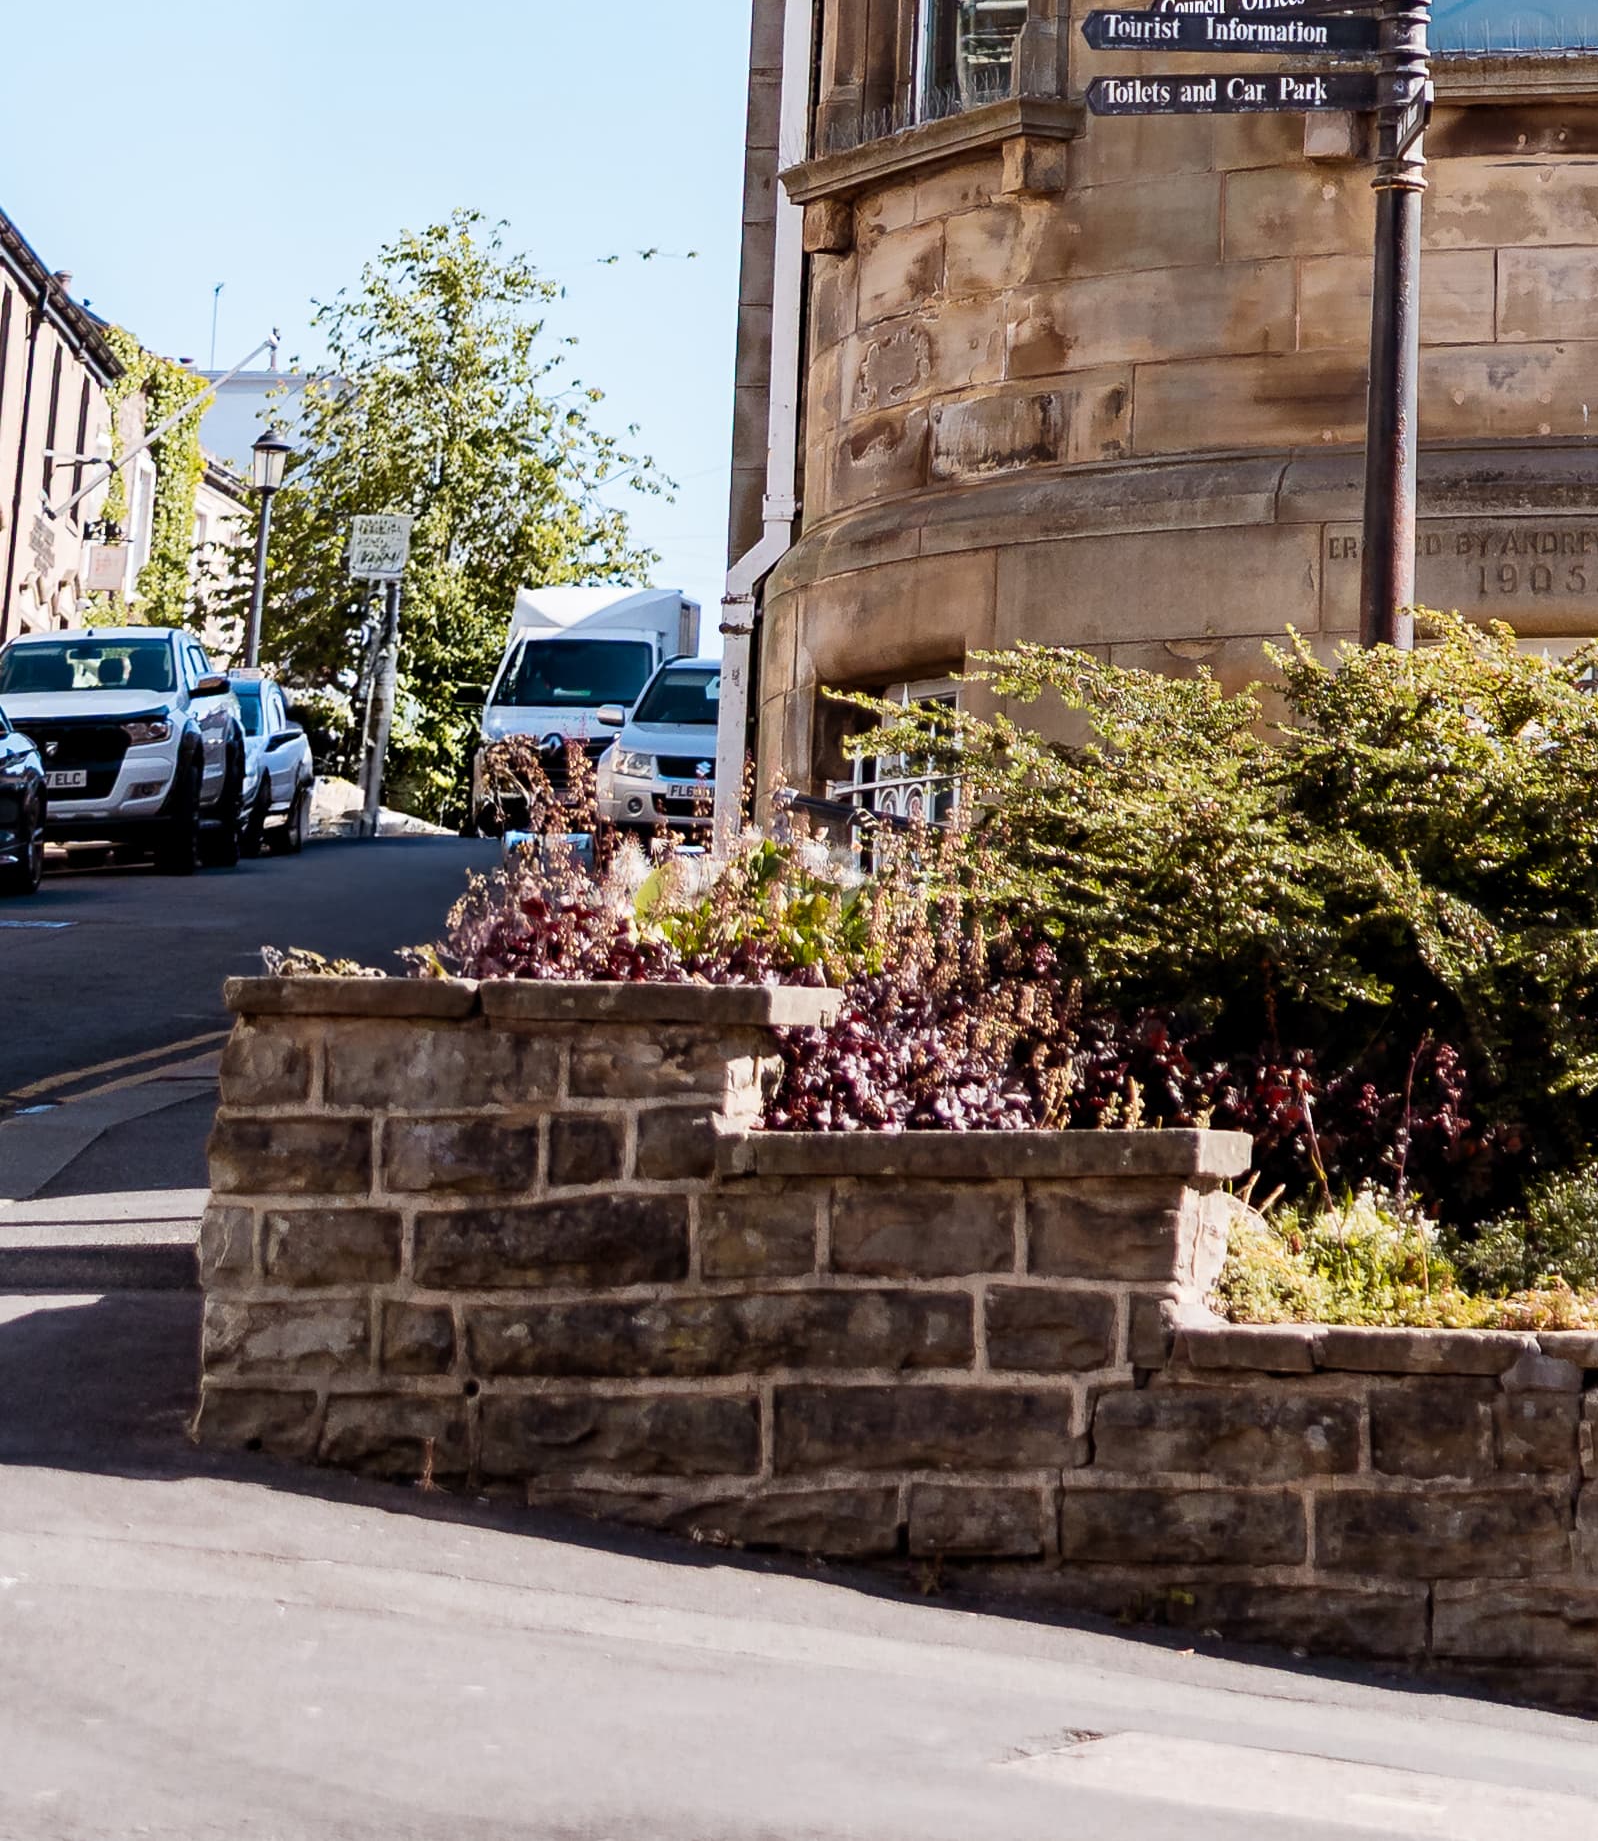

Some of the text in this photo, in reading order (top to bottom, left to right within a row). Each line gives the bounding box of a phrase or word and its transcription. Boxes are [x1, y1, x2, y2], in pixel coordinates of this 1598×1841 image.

[1103, 14, 1328, 44] Tourist Information
[1103, 76, 1328, 104] Toilets and Car Park
[1456, 529, 1491, 557] BY
[55, 772, 82, 786] ELC
